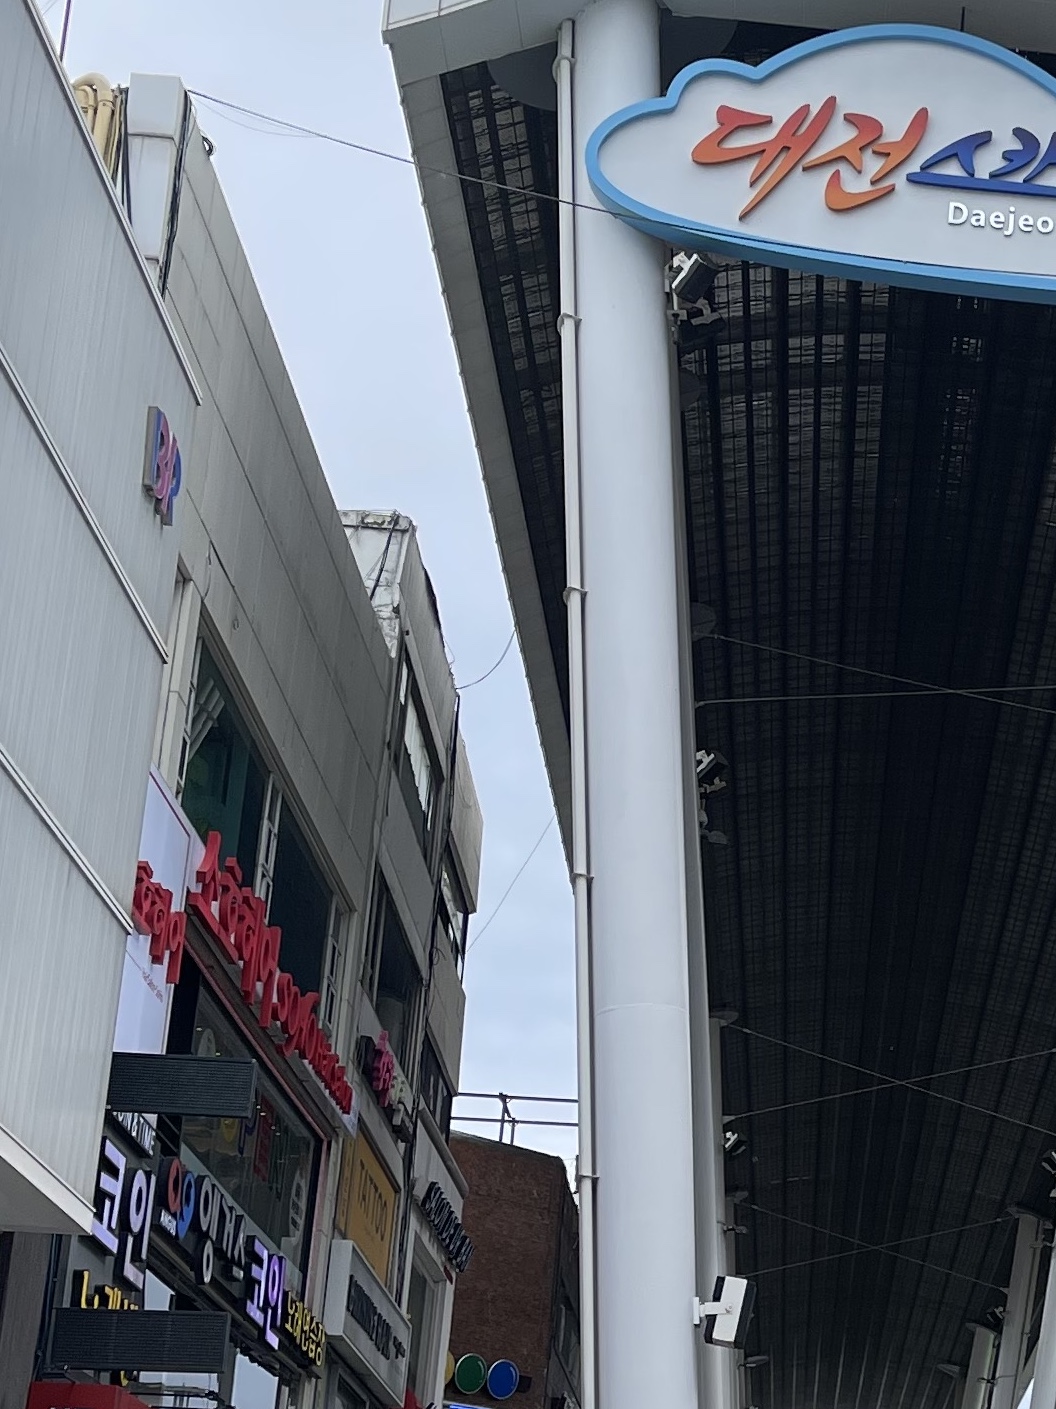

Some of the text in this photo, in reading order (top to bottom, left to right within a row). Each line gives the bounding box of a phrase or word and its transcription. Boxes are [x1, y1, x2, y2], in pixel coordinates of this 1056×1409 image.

[691, 95, 929, 221] 대전
[91, 1137, 157, 1290] 코인
[359, 1159, 389, 1242] TATTOO
[246, 1237, 286, 1351] 코인
[285, 1289, 326, 1366] 노래연습장
